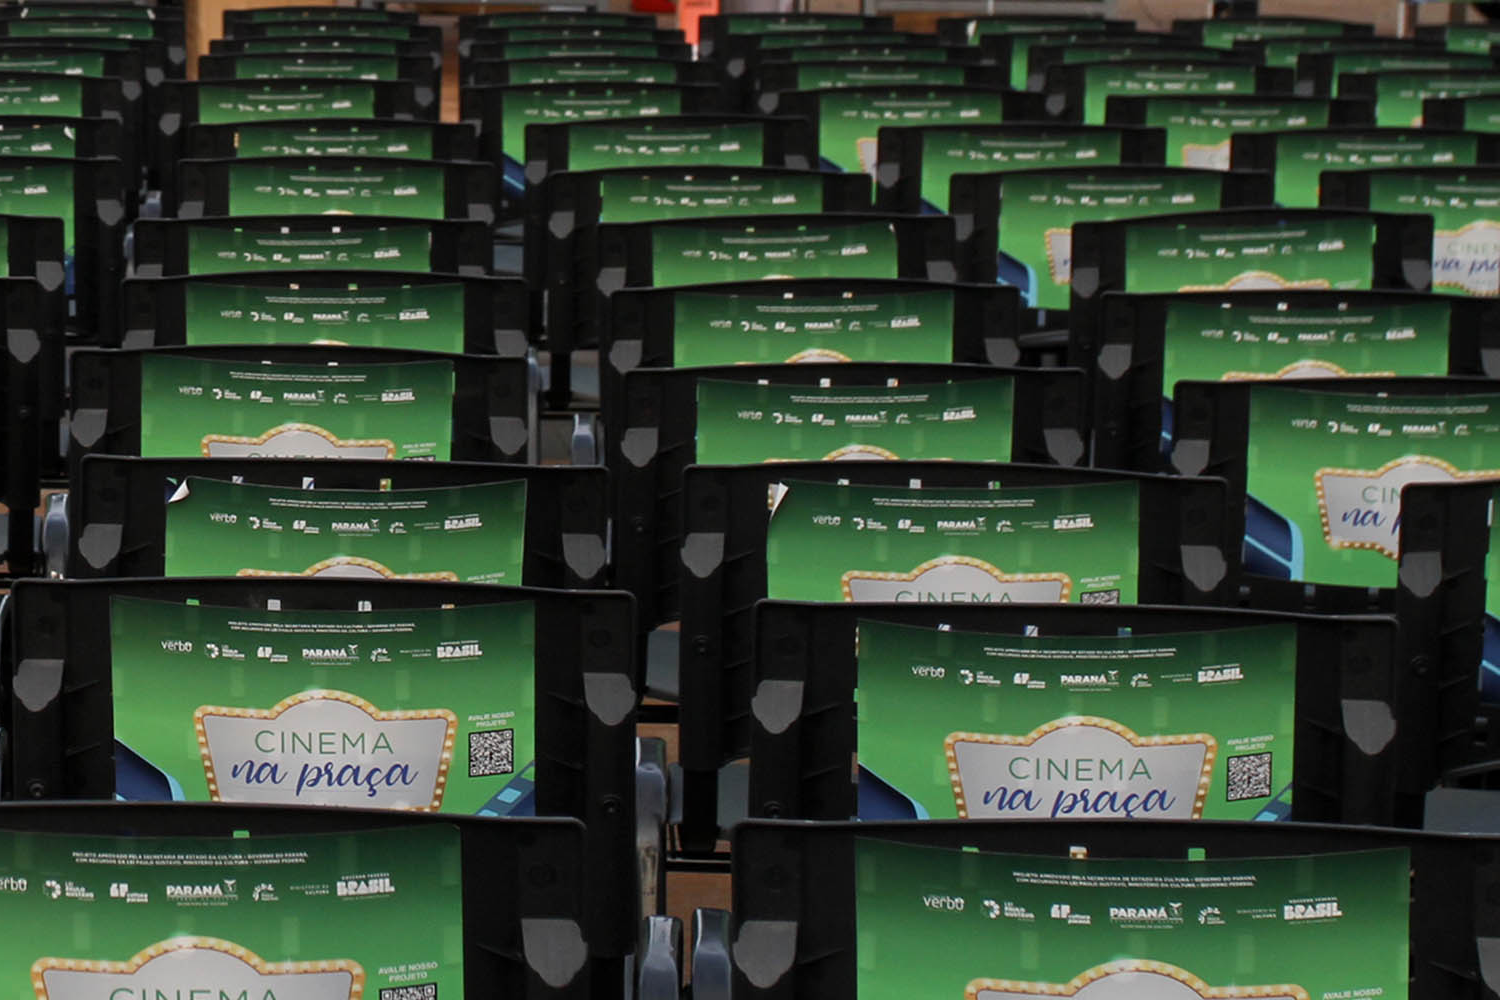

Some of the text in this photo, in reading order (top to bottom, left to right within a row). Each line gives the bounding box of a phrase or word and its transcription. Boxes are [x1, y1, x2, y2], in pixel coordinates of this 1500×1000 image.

[1361, 486, 1401, 504] CIN
[302, 647, 347, 658] PARANÁ
[437, 644, 482, 658] BRASIL
[1060, 673, 1105, 685] PARANÁ
[1198, 667, 1244, 683] BRASIL
[255, 730, 394, 756] CINEMA
[231, 758, 419, 797] na praça
[1009, 756, 1152, 781] CINEMA
[983, 783, 1176, 819] na praça
[166, 884, 223, 897] PARANÁ
[337, 878, 395, 896] BRASIL
[923, 895, 964, 911] verbo
[1283, 902, 1342, 920] BRASIL
[1109, 906, 1167, 919] PARANÁ
[378, 962, 438, 975] AVALIE NOSSO
[388, 972, 428, 982] PROJETO
